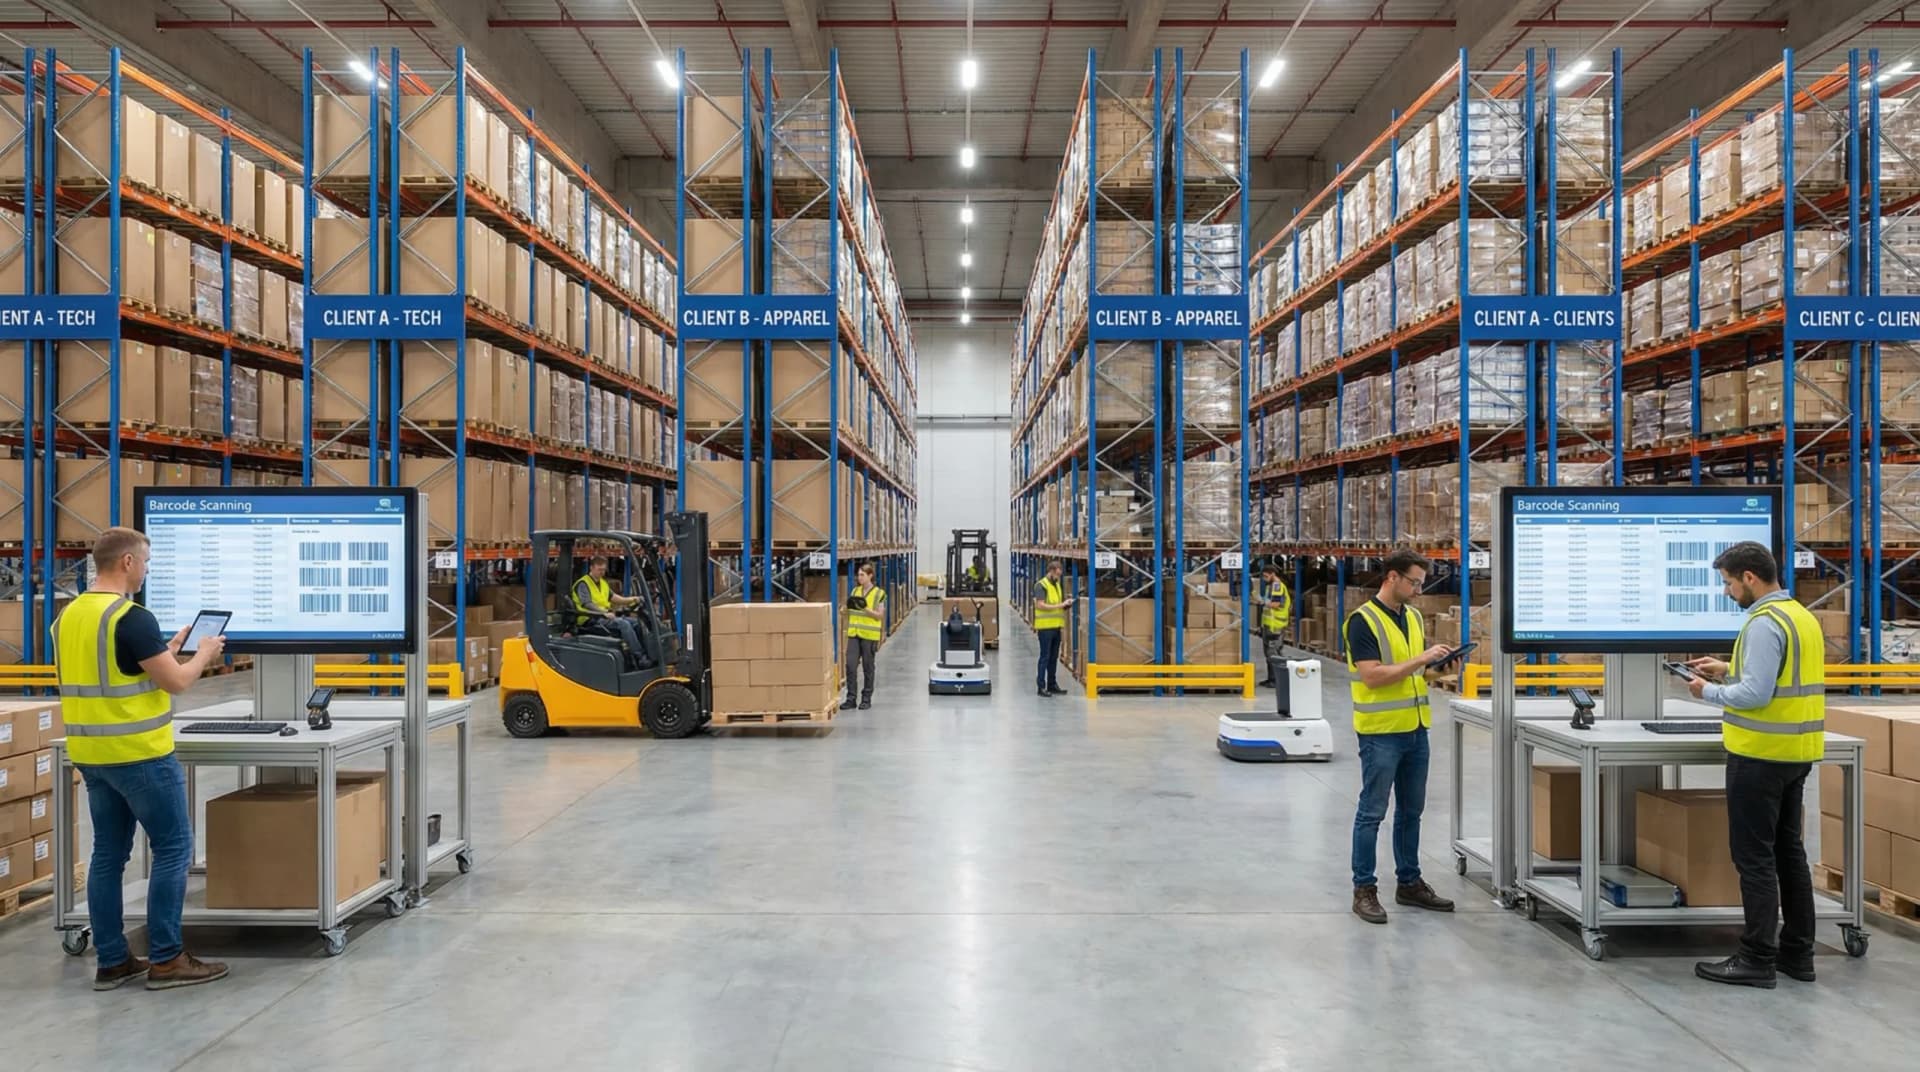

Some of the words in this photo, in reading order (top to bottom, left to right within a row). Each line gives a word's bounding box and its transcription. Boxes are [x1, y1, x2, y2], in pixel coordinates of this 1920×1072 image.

[0, 309, 31, 326] ENT
[33, 309, 45, 326] A
[57, 309, 96, 326] TECH
[323, 309, 376, 326] CLIENT
[378, 309, 390, 326] A
[402, 309, 441, 326] TECH
[683, 309, 736, 326] CLIENT
[739, 309, 751, 326] B
[763, 309, 831, 326] APPAREL
[1095, 309, 1148, 326] CLIENT
[1151, 309, 1162, 326] B
[1175, 309, 1243, 326] APPAREL
[1474, 310, 1526, 327] CLIENT
[1529, 310, 1540, 327] A
[1553, 310, 1615, 327] CLIENTS
[1799, 310, 1852, 327] CLIENT
[1854, 310, 1865, 327] C
[1878, 310, 1920, 327] CLIEN
[149, 500, 196, 511] Barcode
[199, 500, 252, 513] Scanning
[1517, 500, 1564, 511] Barcode
[1567, 500, 1620, 513] Scanning
